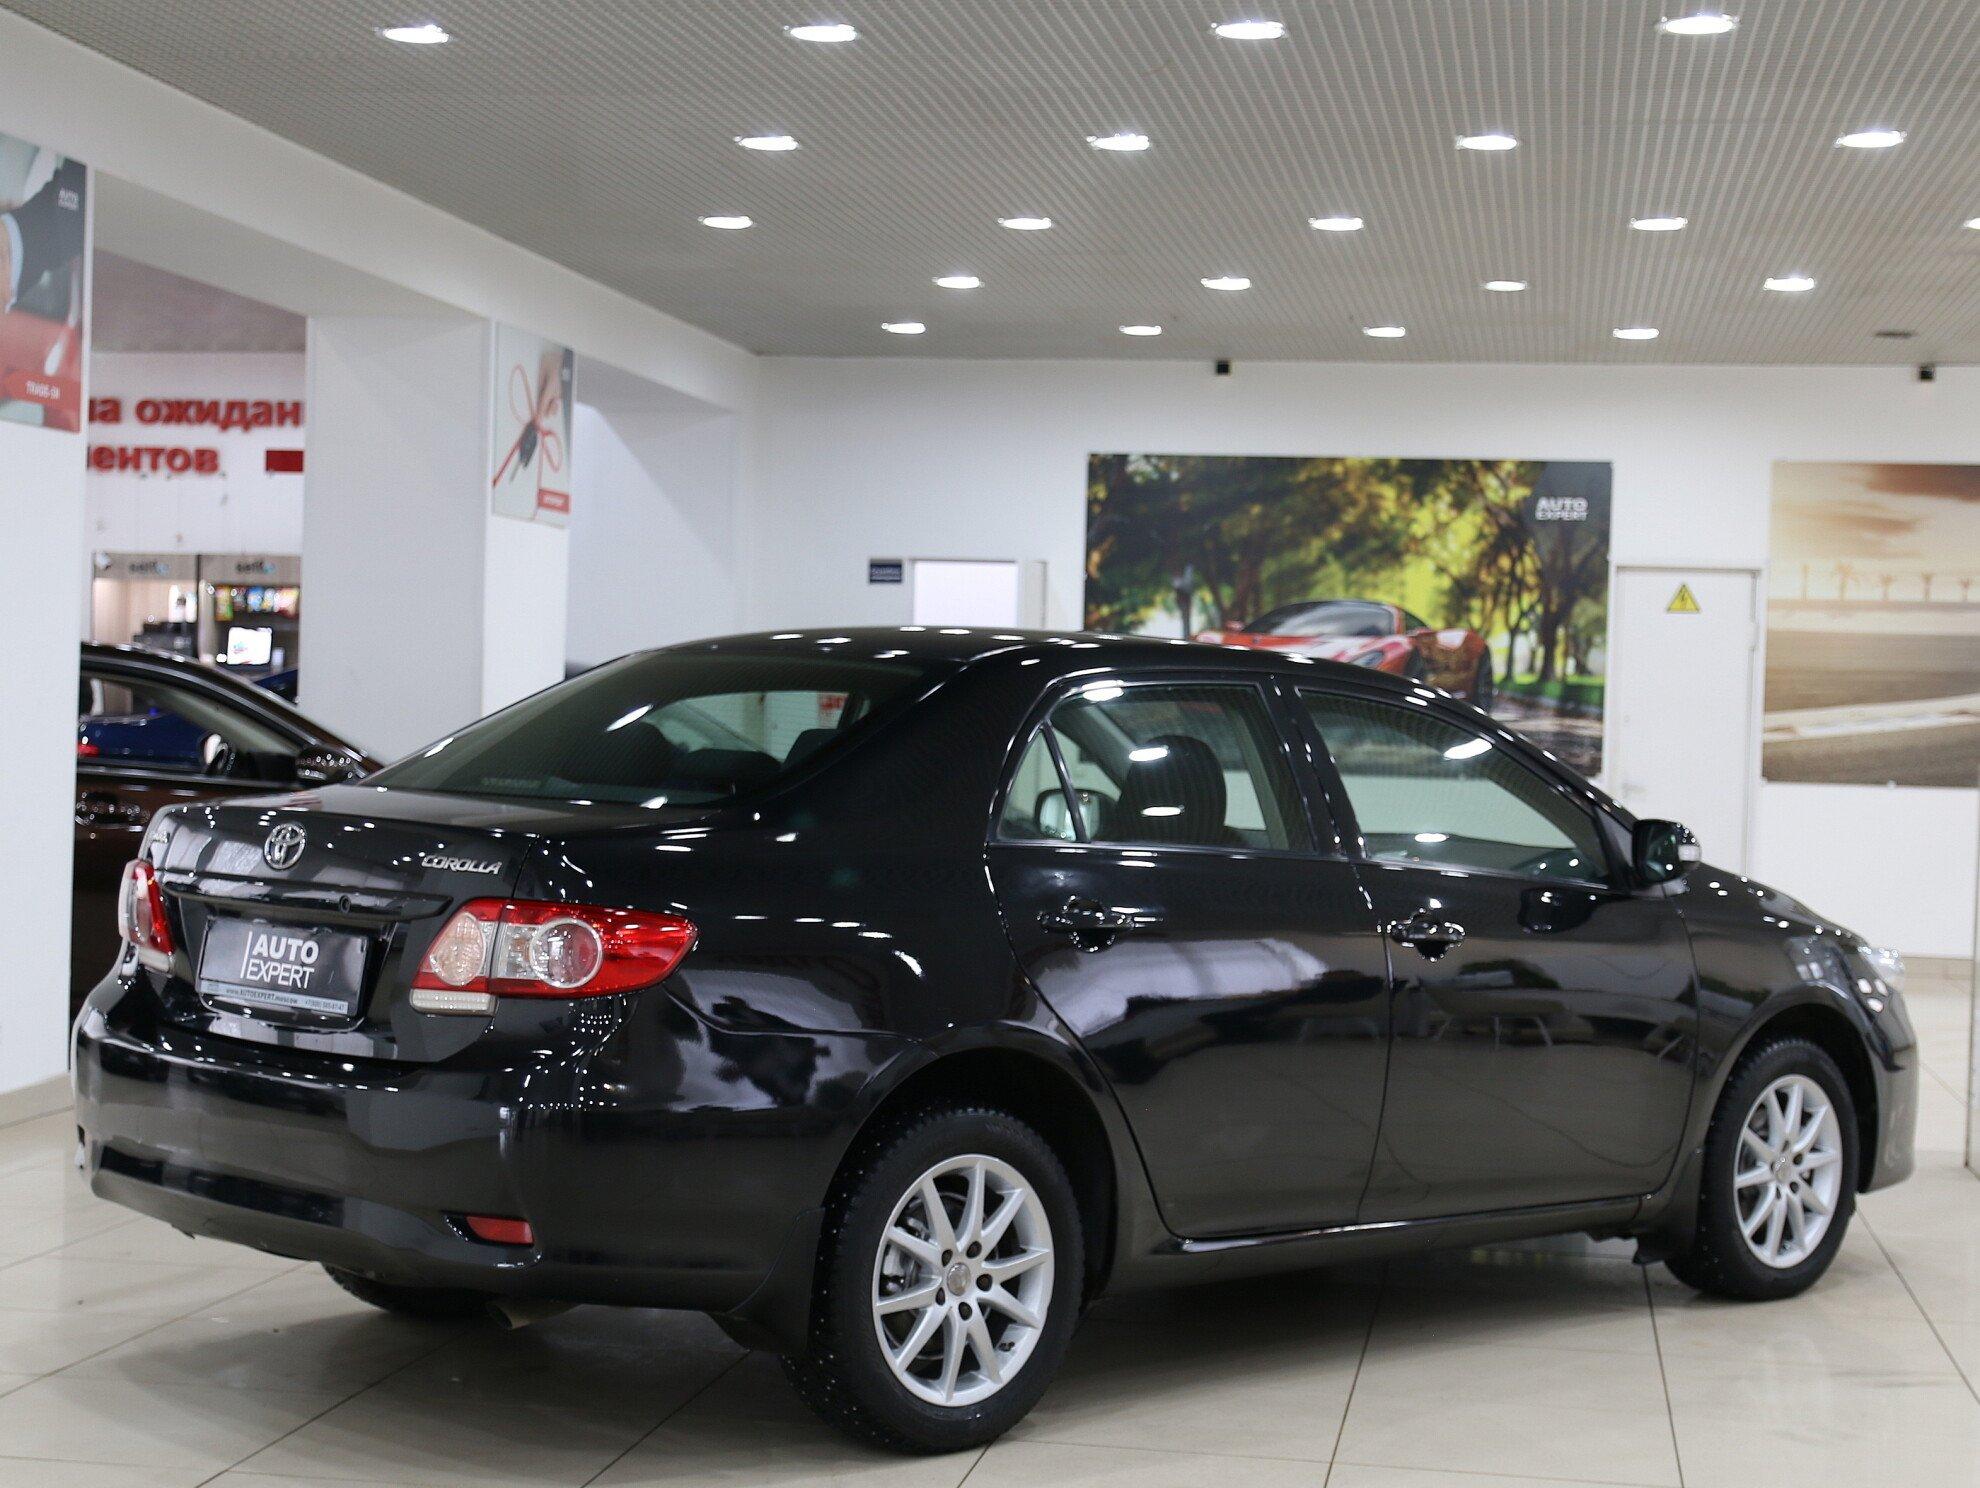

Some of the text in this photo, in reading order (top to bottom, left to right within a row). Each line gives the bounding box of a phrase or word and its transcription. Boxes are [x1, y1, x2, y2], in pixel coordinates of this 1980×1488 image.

[87, 446, 219, 474] ентов
[1536, 496, 1589, 512] AUTO
[421, 854, 502, 875] COROLLA
[252, 933, 319, 964] AUTO
[246, 959, 314, 988] EXPERT
